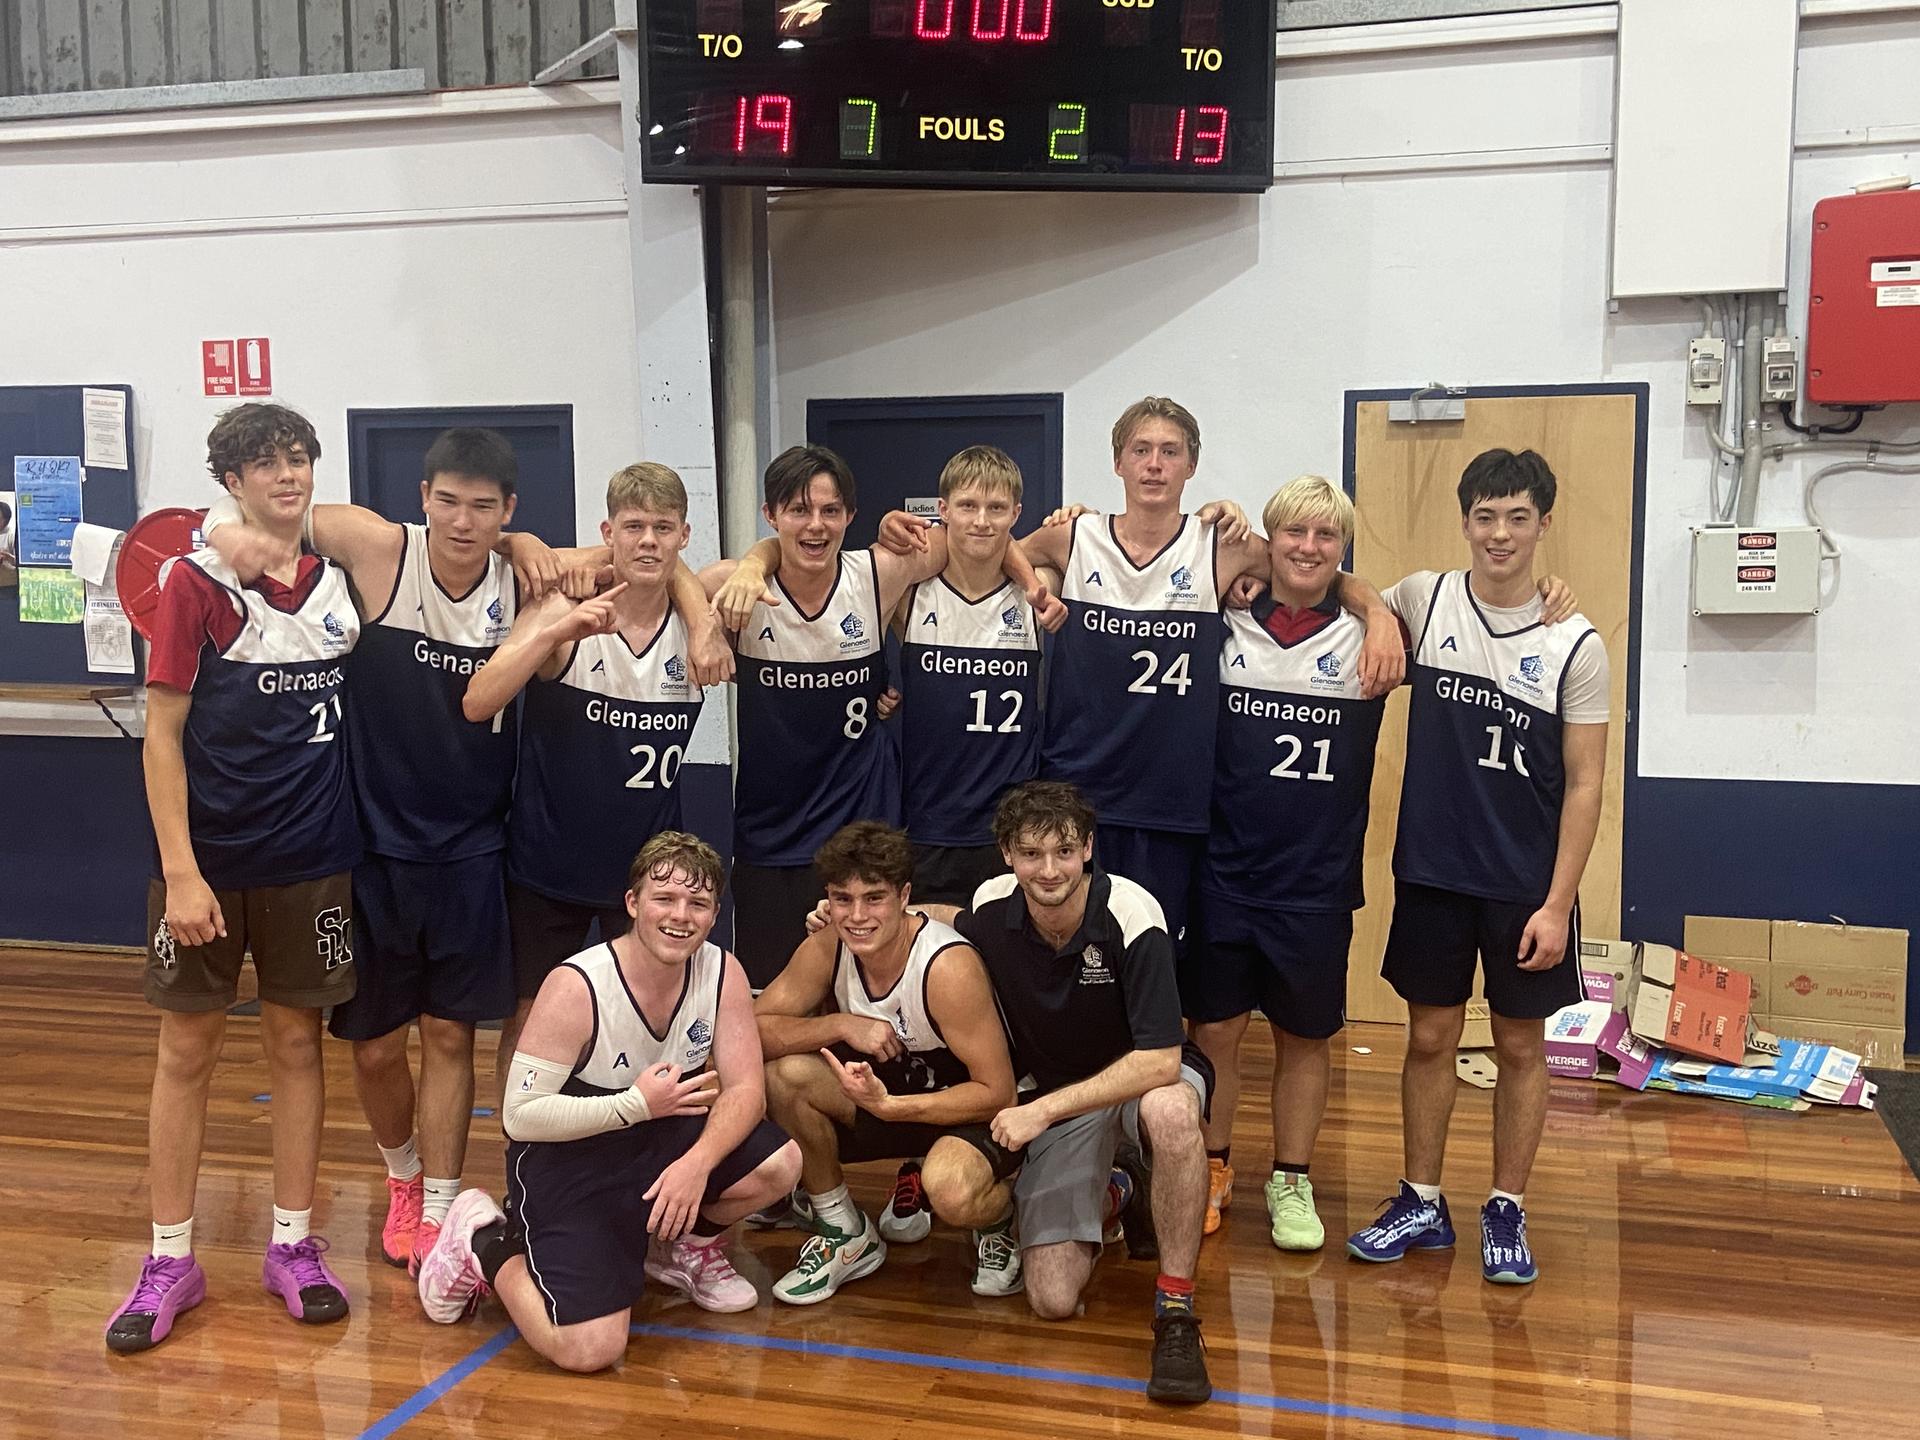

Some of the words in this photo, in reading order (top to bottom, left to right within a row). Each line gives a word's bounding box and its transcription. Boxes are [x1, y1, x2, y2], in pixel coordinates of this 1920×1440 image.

[698, 34, 743, 58] T/O
[1180, 48, 1223, 72] T/O
[736, 95, 792, 153] 19
[847, 98, 878, 156] 7
[919, 117, 1006, 142] FOULS
[1049, 103, 1087, 161] 2
[1174, 107, 1229, 164] 13
[907, 504, 936, 513] Ladies
[1083, 609, 1197, 639] Glenaeon
[759, 666, 870, 690] Glenaeon
[920, 650, 1028, 677] Glenaeon
[1127, 650, 1193, 696] 24
[586, 699, 688, 731] Glenaeon
[843, 696, 868, 740] 8
[966, 689, 1023, 733] 12
[1227, 692, 1342, 726] Glenaeon
[1435, 676, 1532, 731] Glenaon
[625, 744, 683, 790] 20
[1269, 734, 1335, 782] 21
[1545, 1055, 1591, 1067] WERADE
